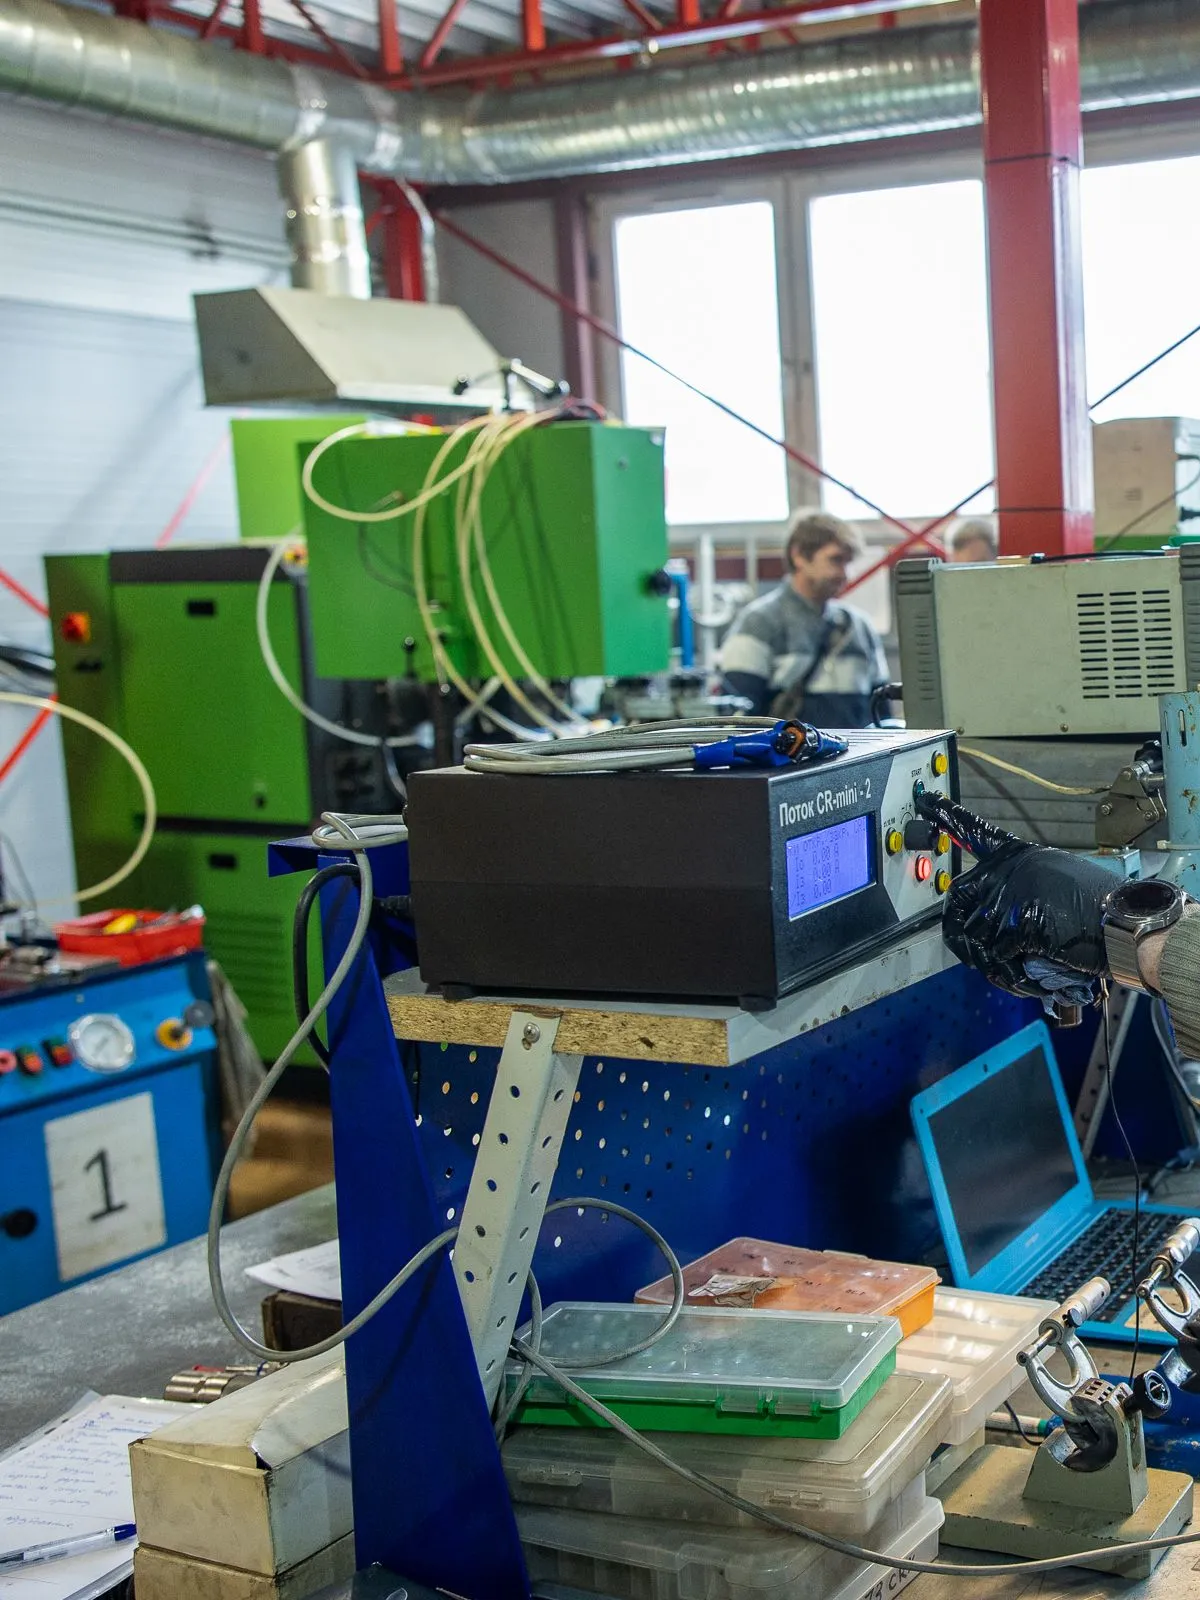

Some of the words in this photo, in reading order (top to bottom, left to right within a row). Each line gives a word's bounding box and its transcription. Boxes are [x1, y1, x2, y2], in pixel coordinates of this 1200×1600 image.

[779, 800, 815, 827] Поток
[816, 782, 858, 815] CR-mini
[865, 777, 872, 799] 2
[84, 1148, 128, 1222] 1
